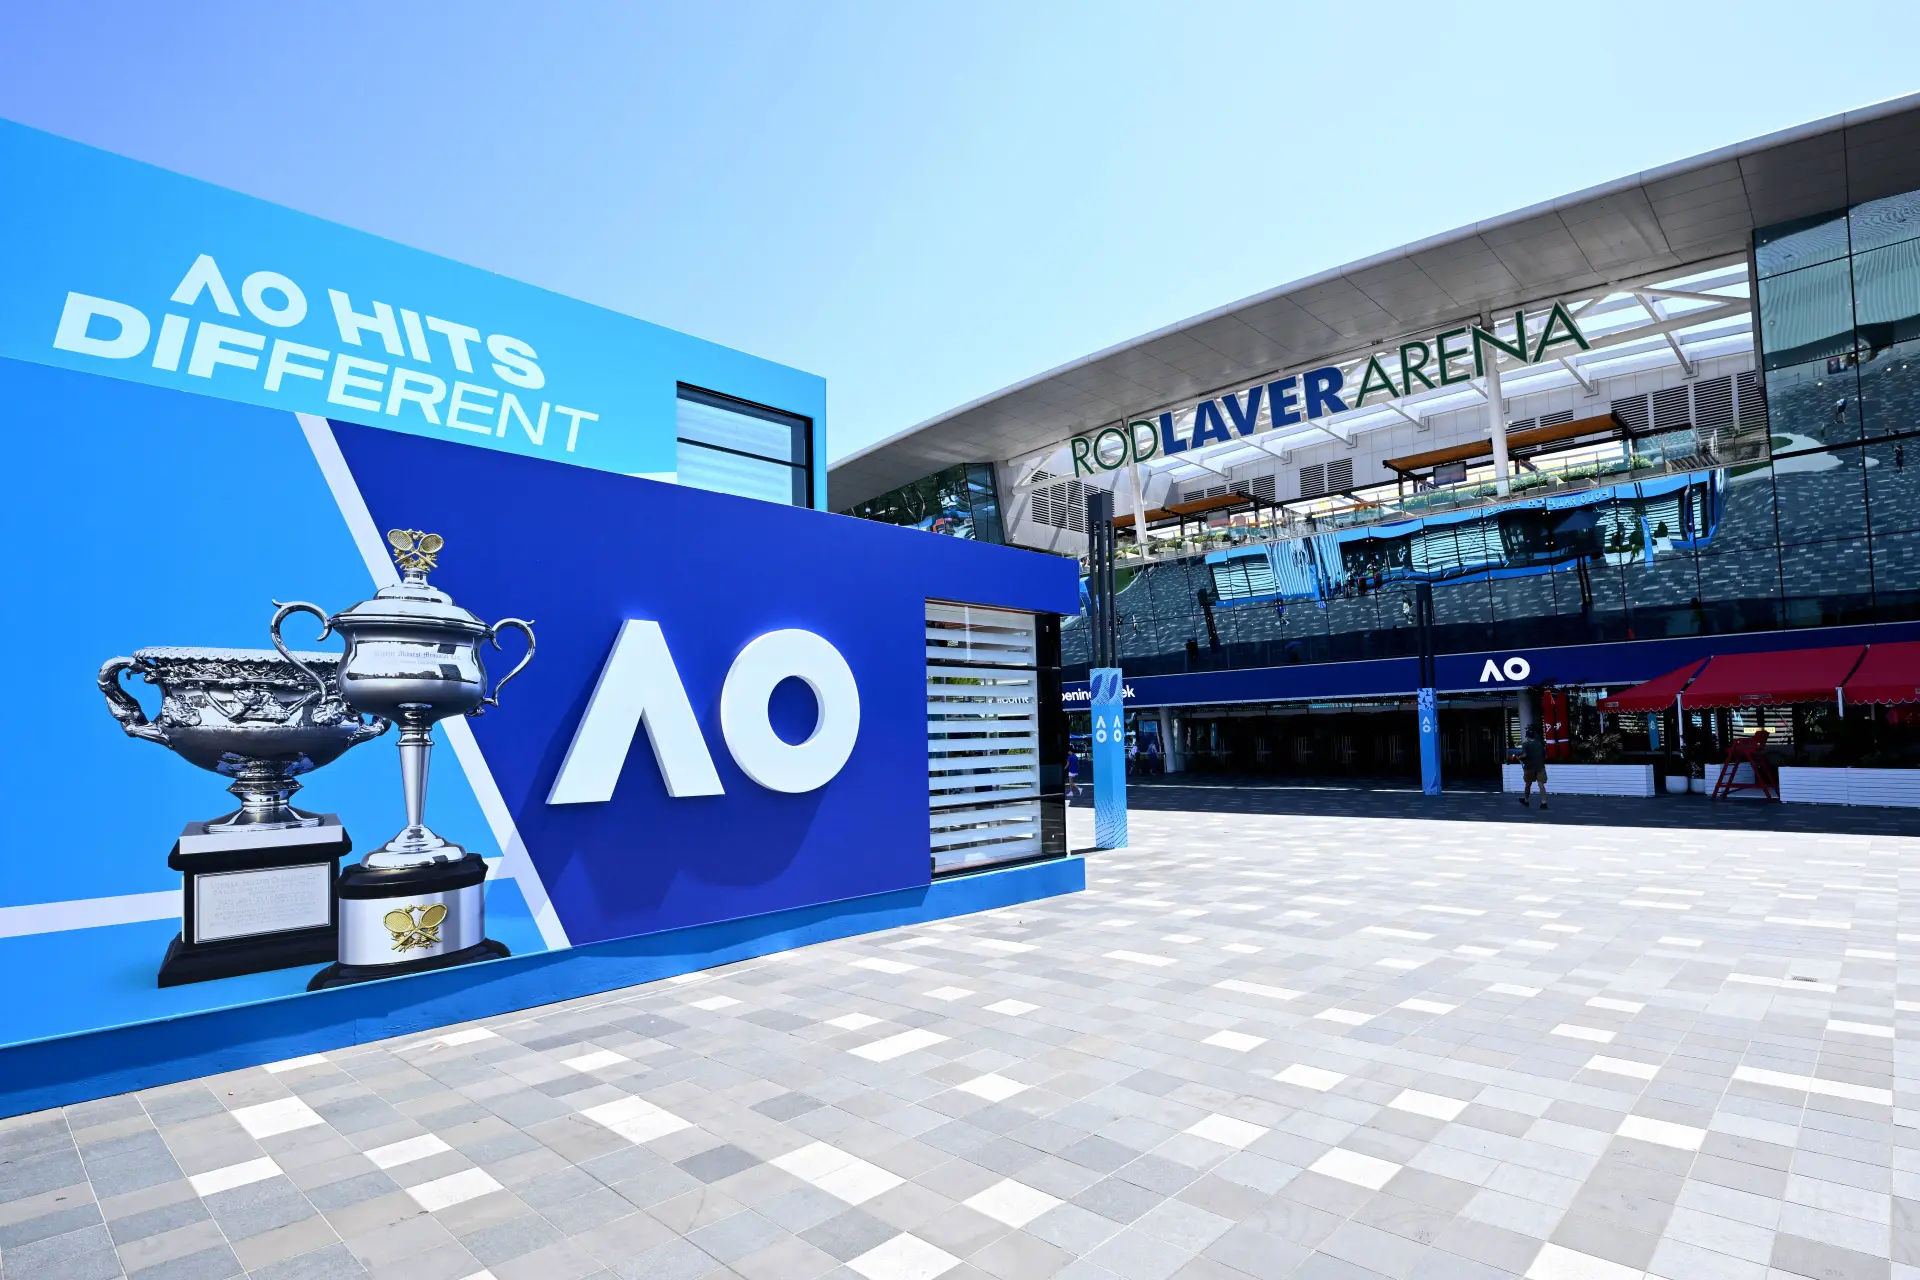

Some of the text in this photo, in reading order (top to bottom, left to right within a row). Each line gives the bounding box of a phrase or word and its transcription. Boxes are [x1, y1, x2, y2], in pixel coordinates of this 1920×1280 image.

[53, 292, 600, 453] DIFFERENT
[171, 254, 546, 390] AO HITS
[1070, 300, 1593, 478] ROD LAVER ARENA
[545, 618, 861, 805] AO
[1479, 656, 1531, 683] AO
